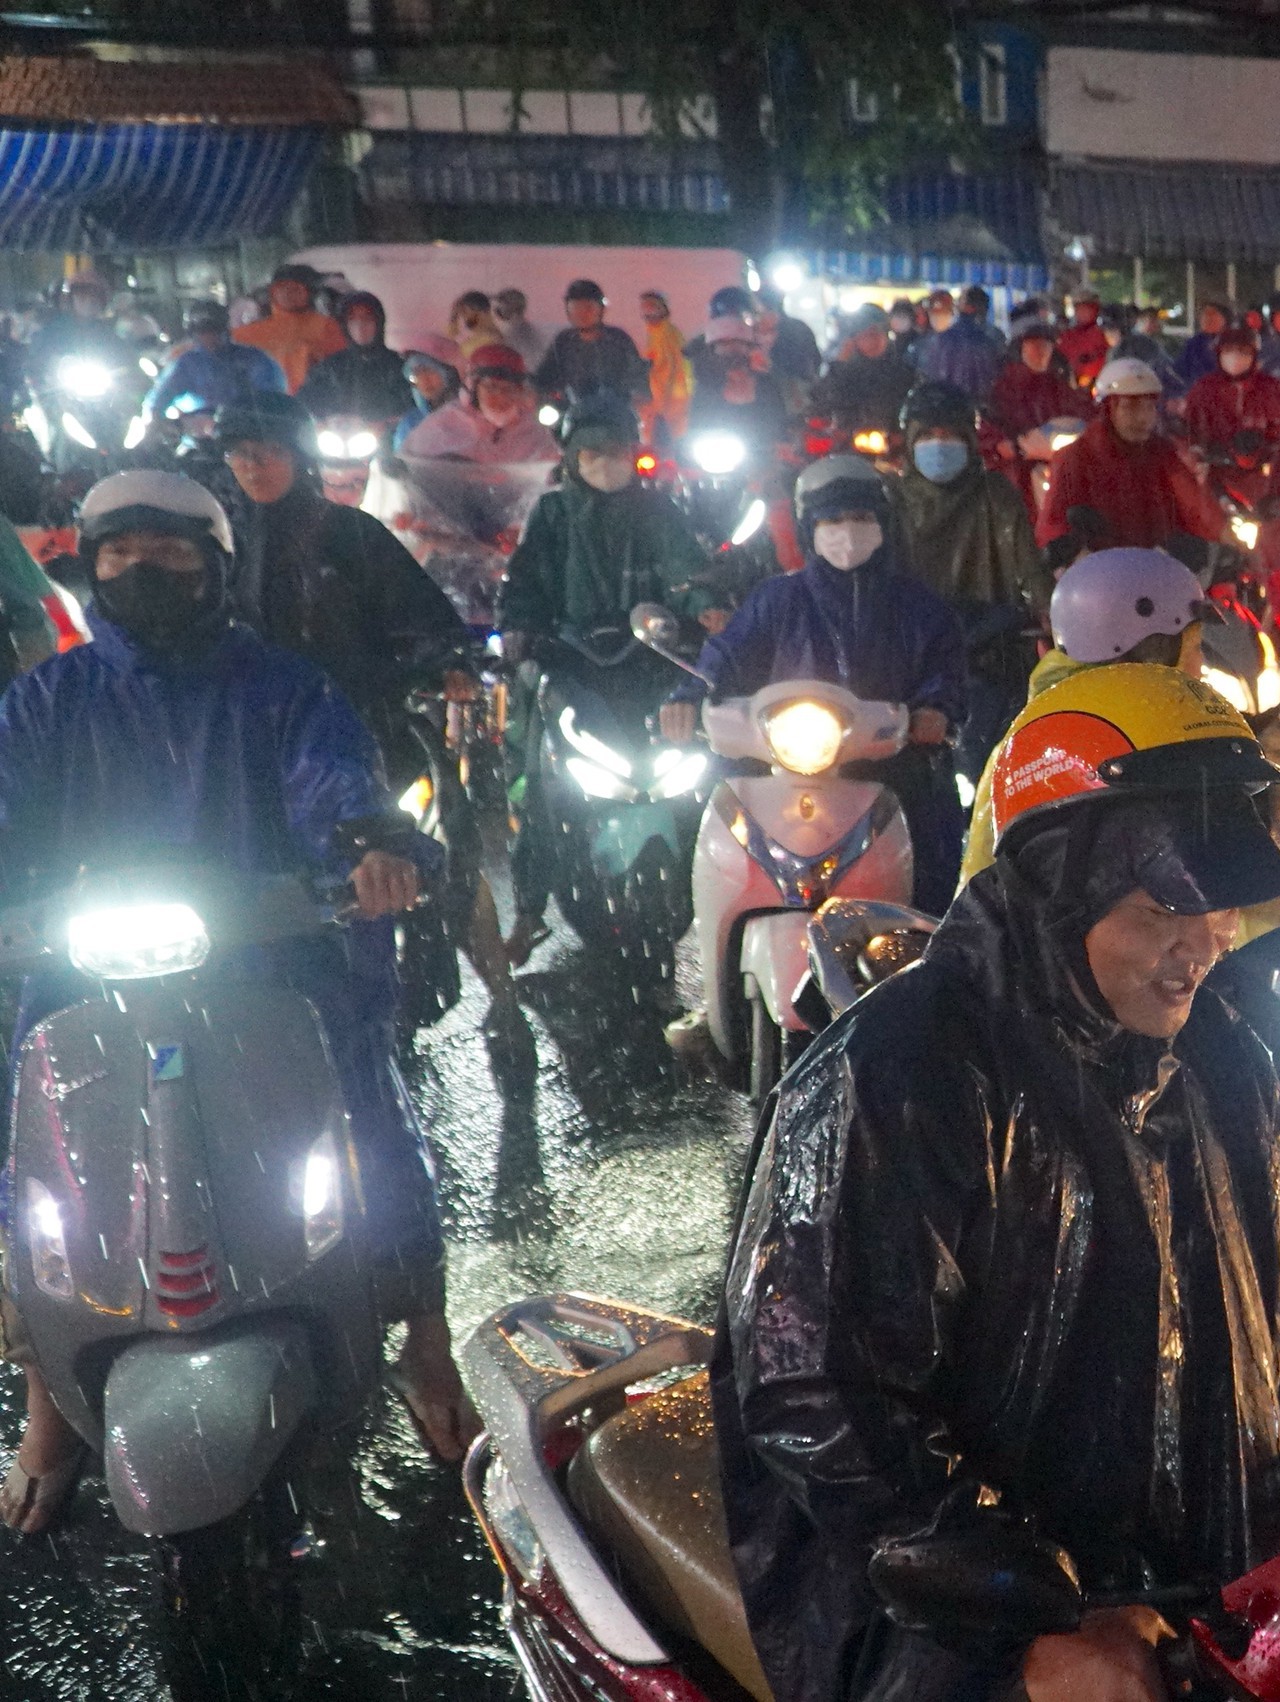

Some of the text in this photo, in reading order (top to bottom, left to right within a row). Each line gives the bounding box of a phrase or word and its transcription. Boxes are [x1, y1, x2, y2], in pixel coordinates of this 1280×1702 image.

[1004, 785, 1015, 799] TO
[1015, 774, 1033, 792] THE
[1033, 758, 1075, 782] WORLD
